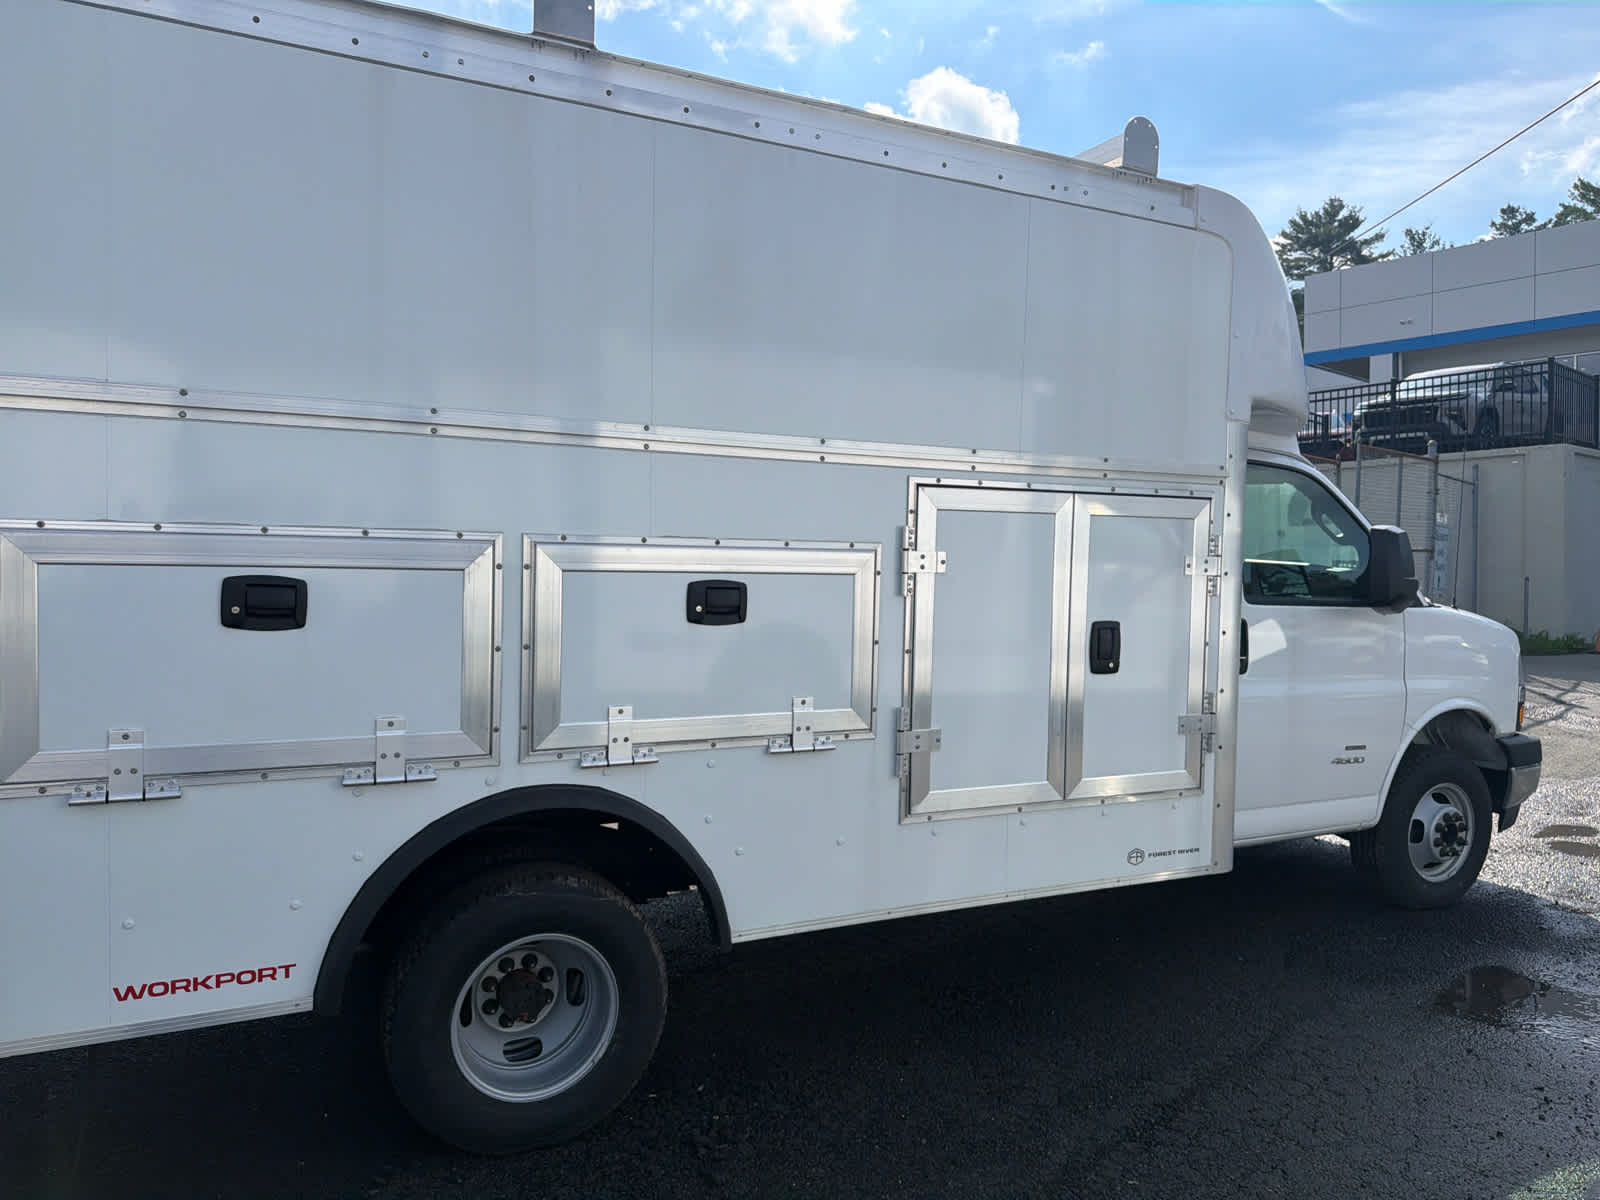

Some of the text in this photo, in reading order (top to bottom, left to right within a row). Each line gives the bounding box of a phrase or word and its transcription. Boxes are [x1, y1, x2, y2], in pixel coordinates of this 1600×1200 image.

[1148, 847, 1200, 858] FOREST RIVER
[112, 963, 297, 1002] WORKPORT
